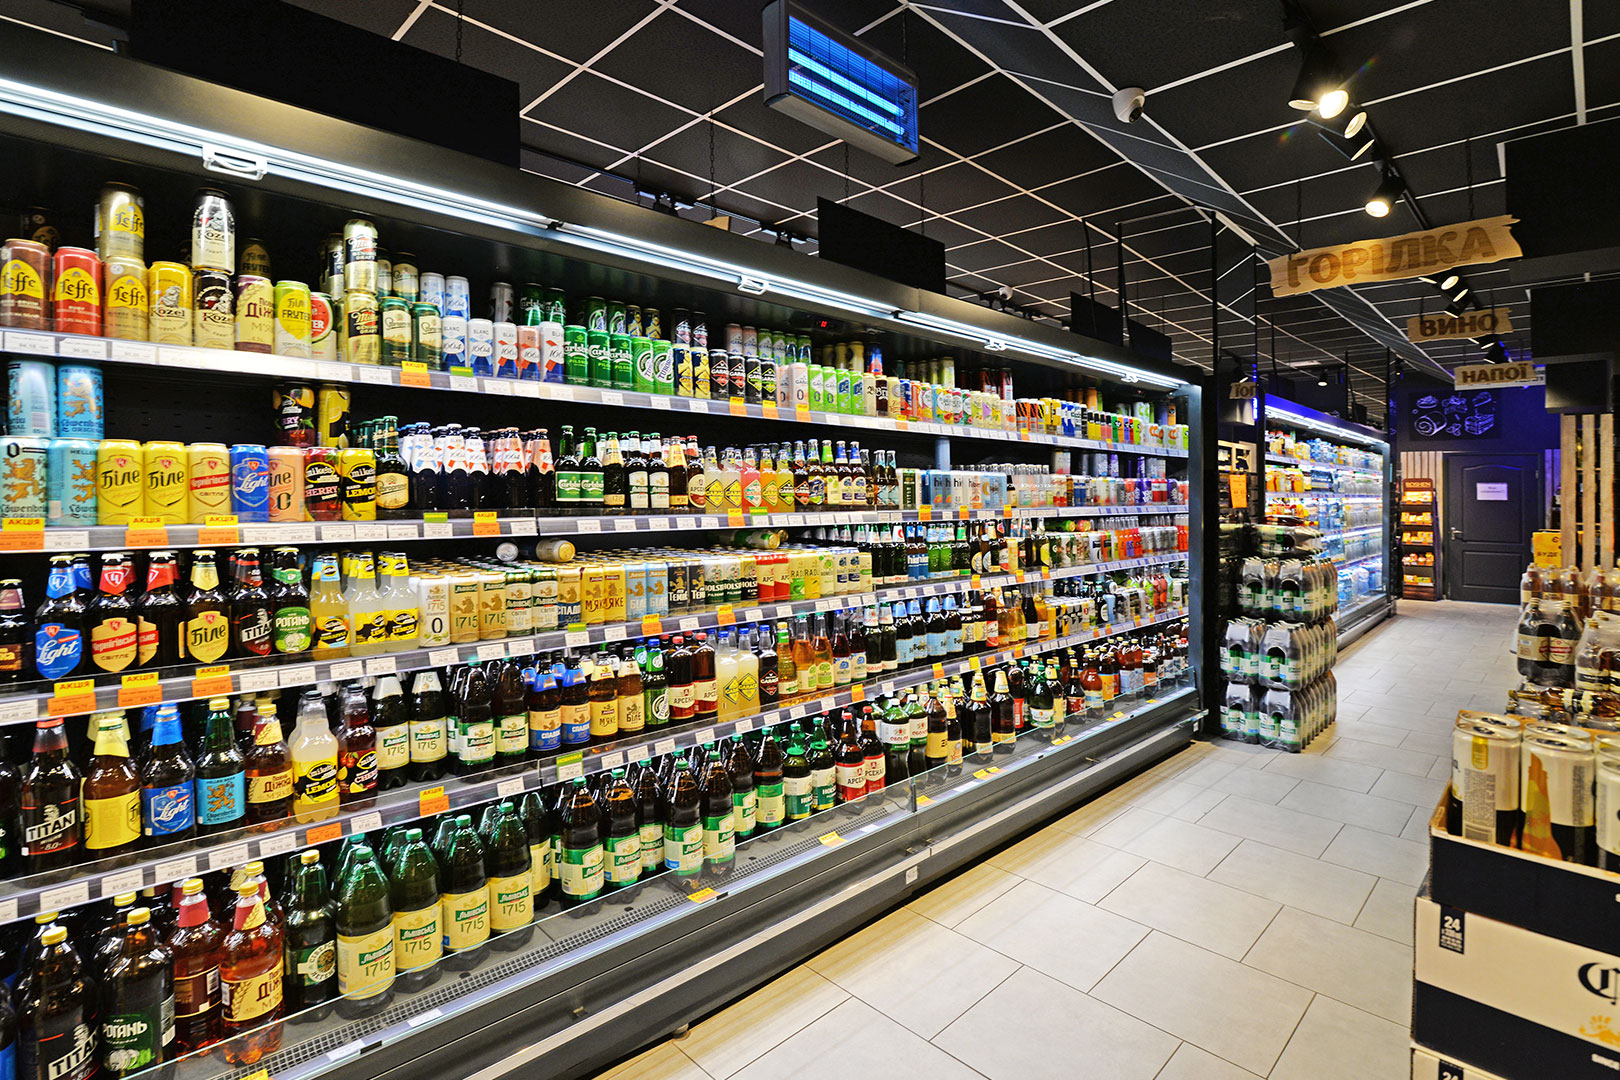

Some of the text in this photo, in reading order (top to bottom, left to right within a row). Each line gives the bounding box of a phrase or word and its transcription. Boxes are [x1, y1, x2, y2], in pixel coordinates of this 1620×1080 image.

[115, 211, 144, 231] Leffe
[1287, 227, 1497, 288] ГОРІЛКА
[2, 272, 37, 293] Leffe
[59, 277, 94, 299] Leffe
[113, 284, 145, 306] Leffe
[150, 302, 186, 319] Kozel
[1419, 313, 1499, 337] ВИНО
[1462, 363, 1528, 384] НАПОЇ
[7, 443, 20, 458] 0
[101, 469, 140, 489] Біле
[148, 470, 185, 490] Біле
[235, 473, 269, 493] Light
[269, 472, 292, 486] іле
[277, 493, 292, 510] 0
[305, 486, 338, 497] HERRY
[275, 616, 310, 628] РОГАНЬ
[431, 617, 443, 633] 0
[455, 615, 478, 629] 1715
[484, 611, 507, 626] 1715
[190, 624, 227, 646] Біле
[36, 639, 80, 666] Light
[387, 745, 406, 755] 1715
[417, 740, 437, 751] 1715
[156, 800, 190, 821] Light
[28, 812, 74, 840] TITAN
[502, 901, 526, 915] 1715
[460, 917, 484, 934] 1715
[1443, 915, 1461, 931] 24
[404, 938, 432, 954] 1715
[365, 957, 391, 977] 1715
[53, 1037, 98, 1076] TITA
